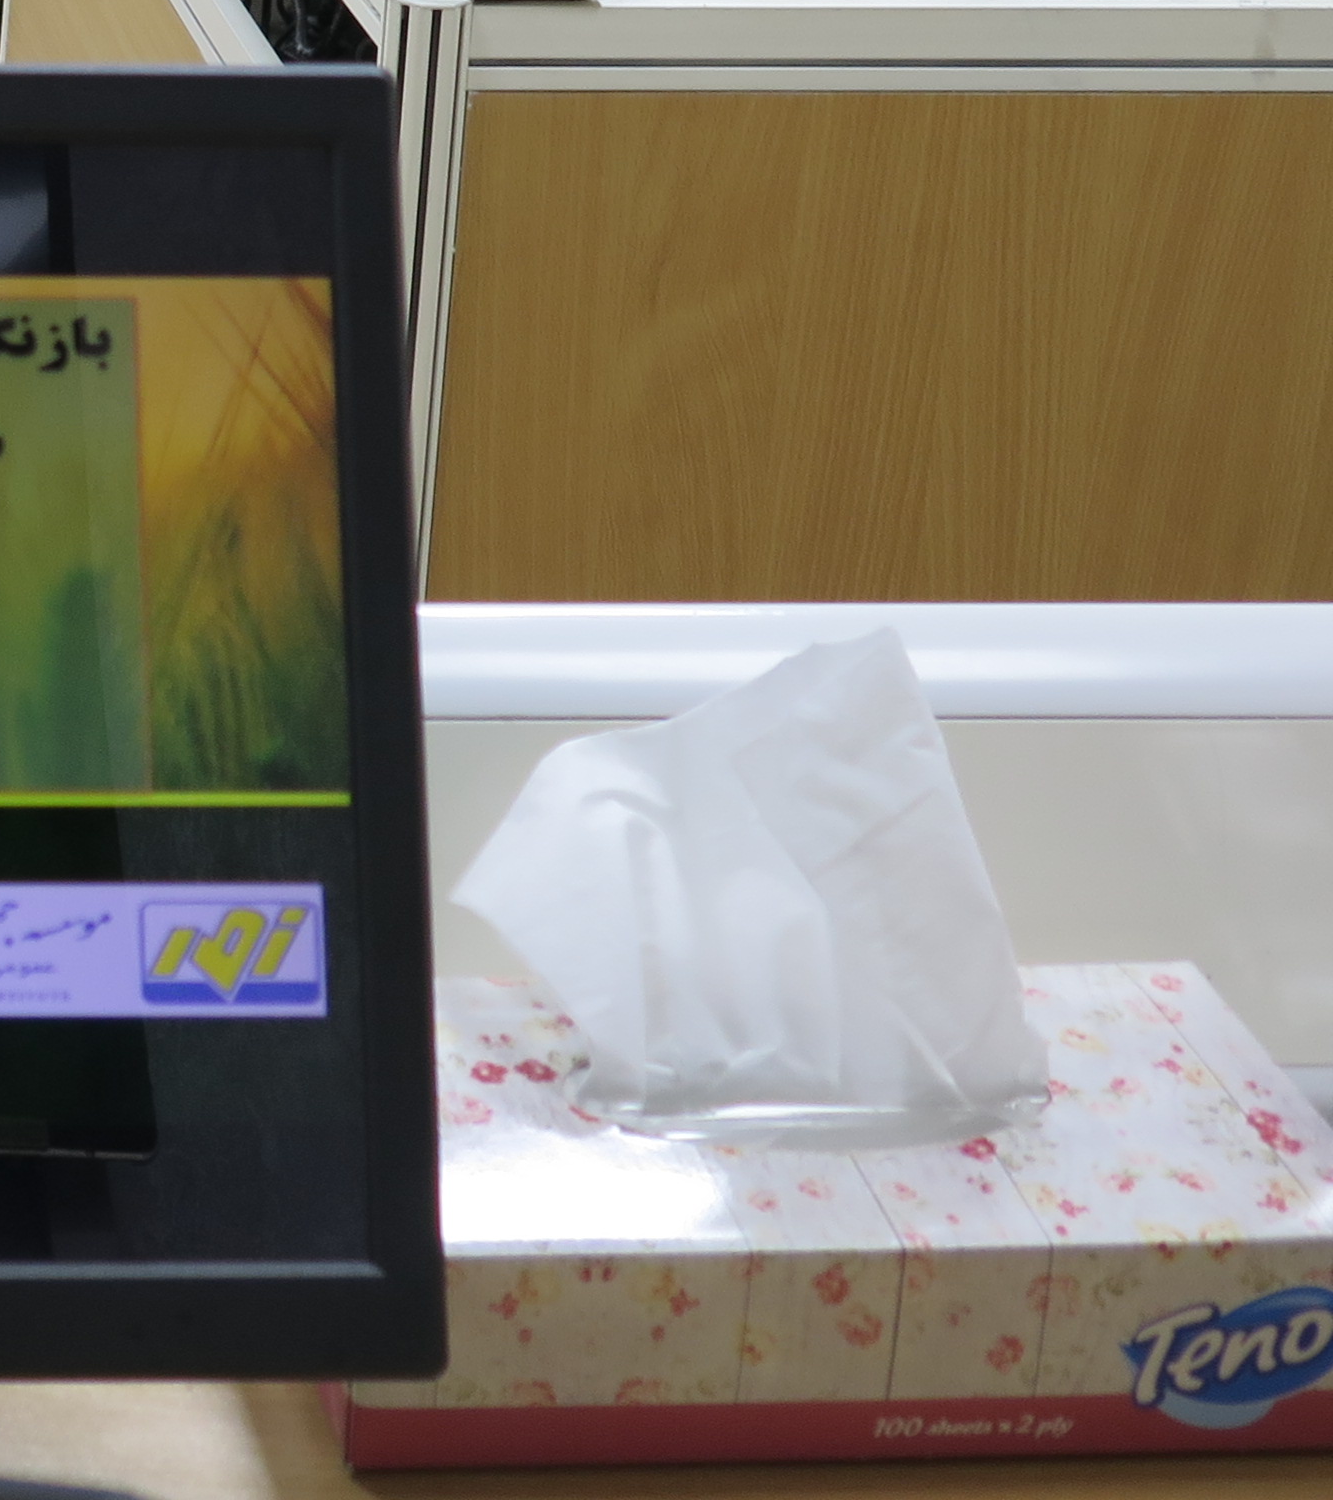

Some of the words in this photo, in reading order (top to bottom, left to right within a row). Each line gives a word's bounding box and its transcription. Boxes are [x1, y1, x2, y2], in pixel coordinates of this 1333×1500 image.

[1135, 1304, 1333, 1405] Teno
[874, 1417, 923, 1438] 100
[1016, 1415, 1034, 1434] 2
